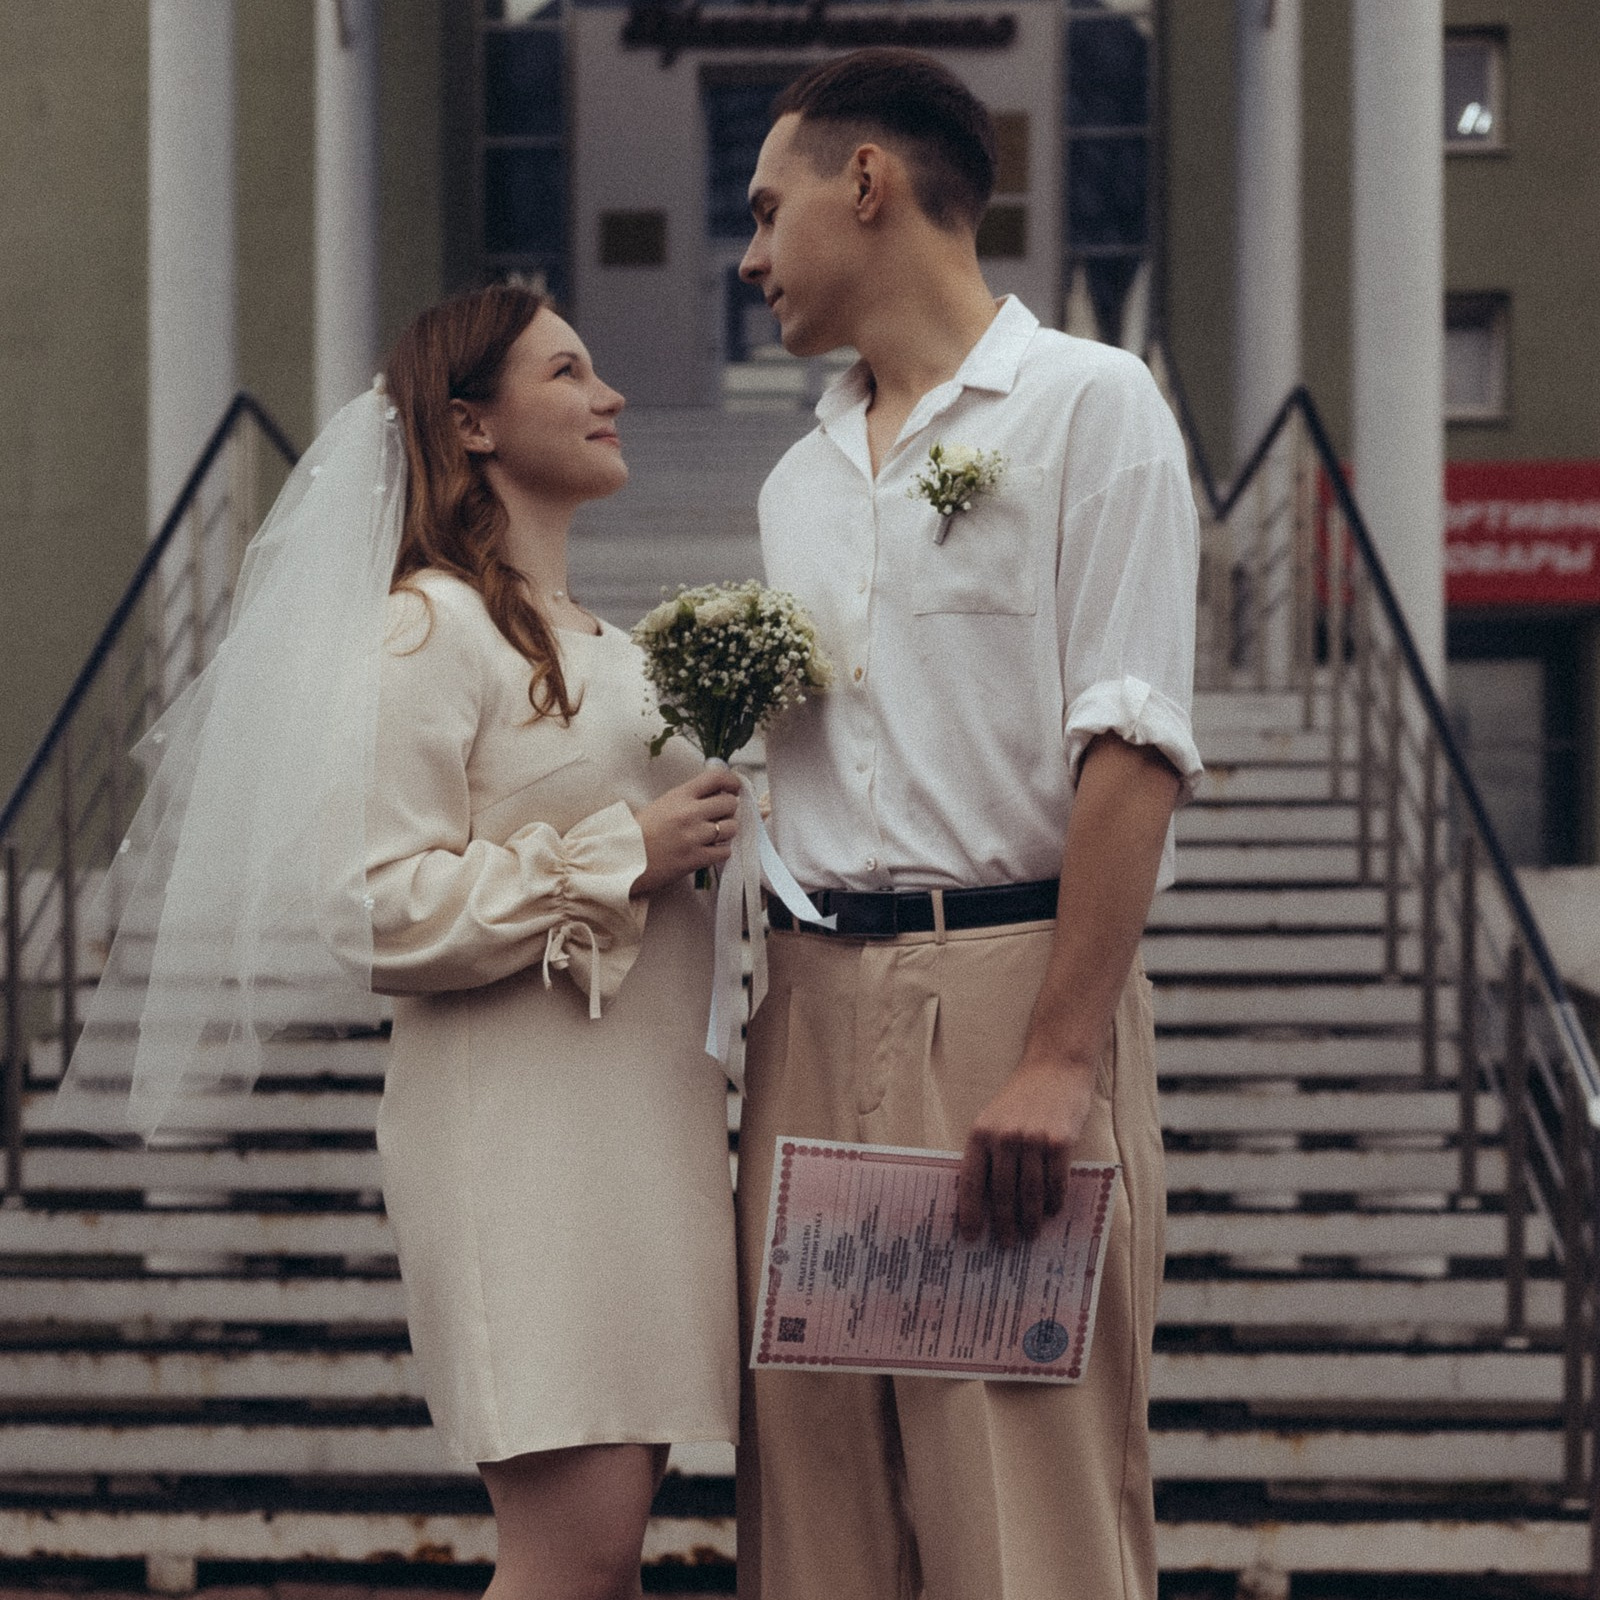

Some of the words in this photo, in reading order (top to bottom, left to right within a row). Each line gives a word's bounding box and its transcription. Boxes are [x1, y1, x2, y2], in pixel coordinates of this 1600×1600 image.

[797, 1224, 811, 1292] СВИДЕТЕЛЬСТВО
[805, 1241, 819, 1296] ЗАКЛЮЧЕНИИ
[813, 1212, 822, 1239] БРАКА
